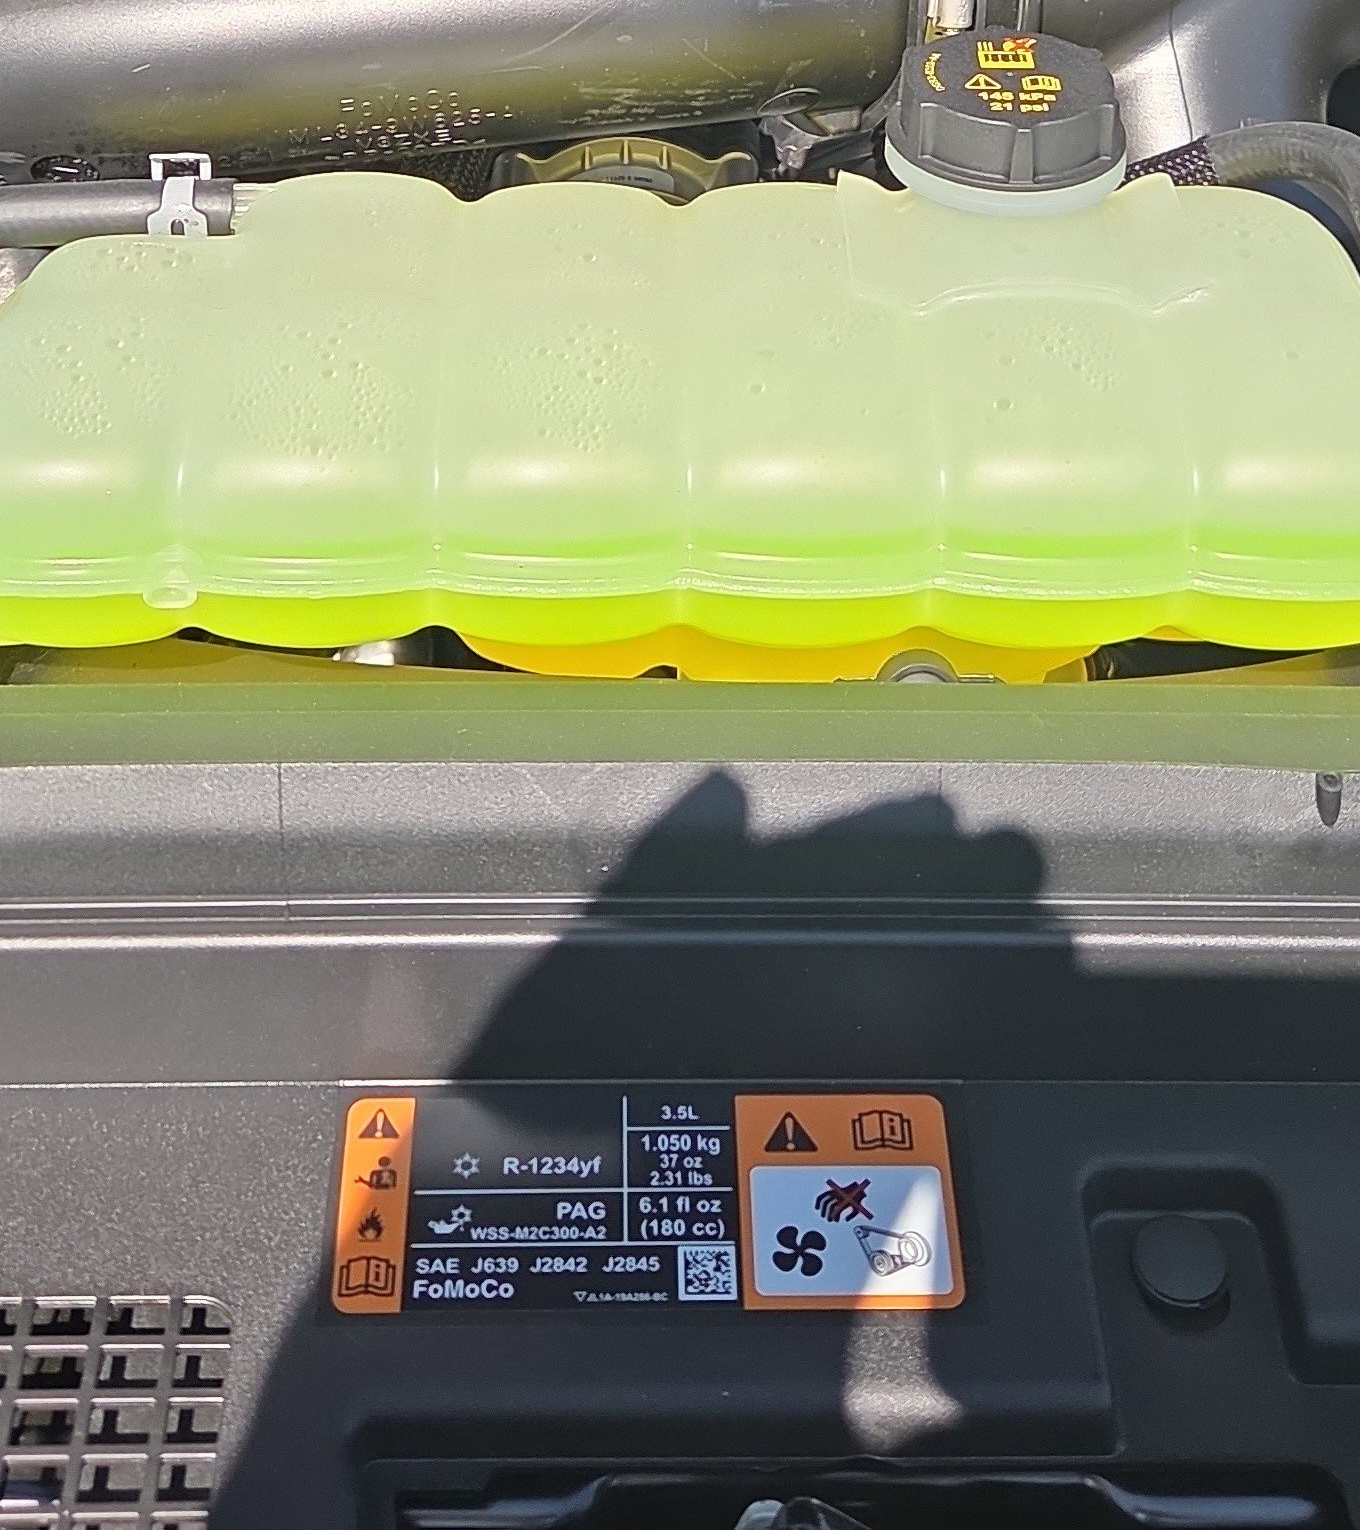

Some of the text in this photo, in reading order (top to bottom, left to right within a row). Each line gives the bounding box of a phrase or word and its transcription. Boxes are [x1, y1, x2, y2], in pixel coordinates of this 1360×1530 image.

[1018, 92, 1057, 102] kPa
[989, 102, 1050, 113] 21 psi
[660, 1104, 699, 1120] 3.5L
[640, 1133, 721, 1156] 1.050 kg
[502, 1155, 602, 1178] R-1234yf
[659, 1153, 704, 1169] 37 oz
[649, 1170, 714, 1186] 2.31 lbs
[556, 1201, 607, 1220] PAG
[638, 1196, 722, 1213] 6.1 fl oz
[470, 1225, 607, 1241] WSS-M2C300-A2
[640, 1218, 726, 1240] (180 cc)
[415, 1256, 661, 1274] SAE J639 J2842 J2845
[412, 1278, 515, 1299] FoMoCo
